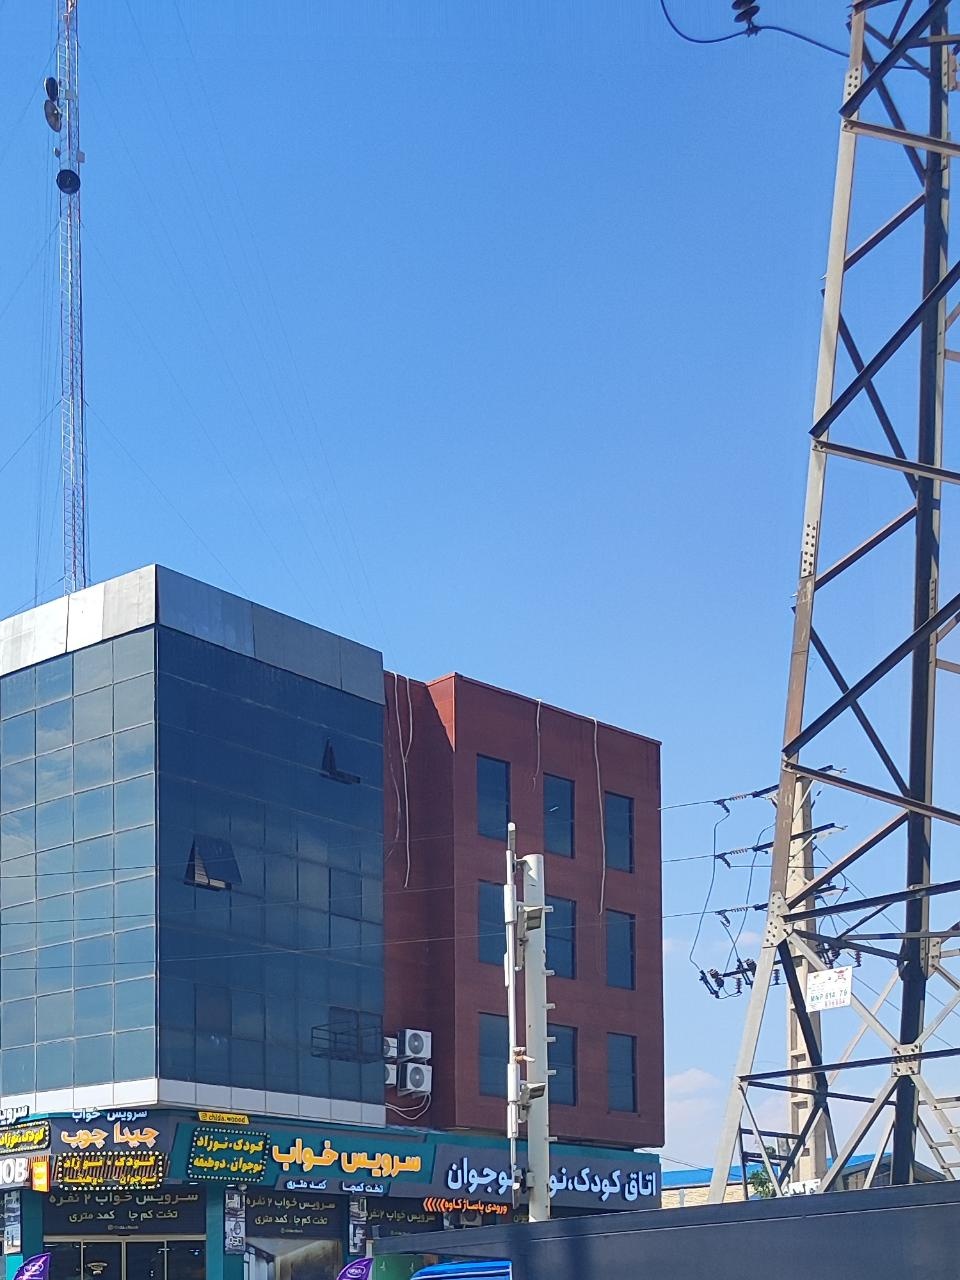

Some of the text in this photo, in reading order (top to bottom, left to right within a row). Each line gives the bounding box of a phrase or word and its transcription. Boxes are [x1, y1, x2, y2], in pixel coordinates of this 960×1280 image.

[72, 1107, 148, 1122] سرویس خواب
[272, 1138, 421, 1177] سرویس خواب
[309, 1180, 327, 1190] کمد
[365, 1184, 384, 1192] تخت
[624, 1170, 657, 1201] اتاق
[49, 1193, 80, 1206] نفره
[95, 1192, 132, 1204] خواب
[136, 1194, 198, 1205] سرویس
[246, 1197, 267, 1208] نفره
[275, 1198, 297, 1209] خواب
[298, 1200, 336, 1210] سرویس
[444, 1199, 508, 1214] ورودی پاساژ کاوه
[69, 1212, 94, 1222] متری
[96, 1210, 115, 1220] کمد
[156, 1211, 178, 1219] تخت
[255, 1215, 274, 1226] متری
[275, 1214, 288, 1223] کمد
[312, 1217, 328, 1225] تخت
